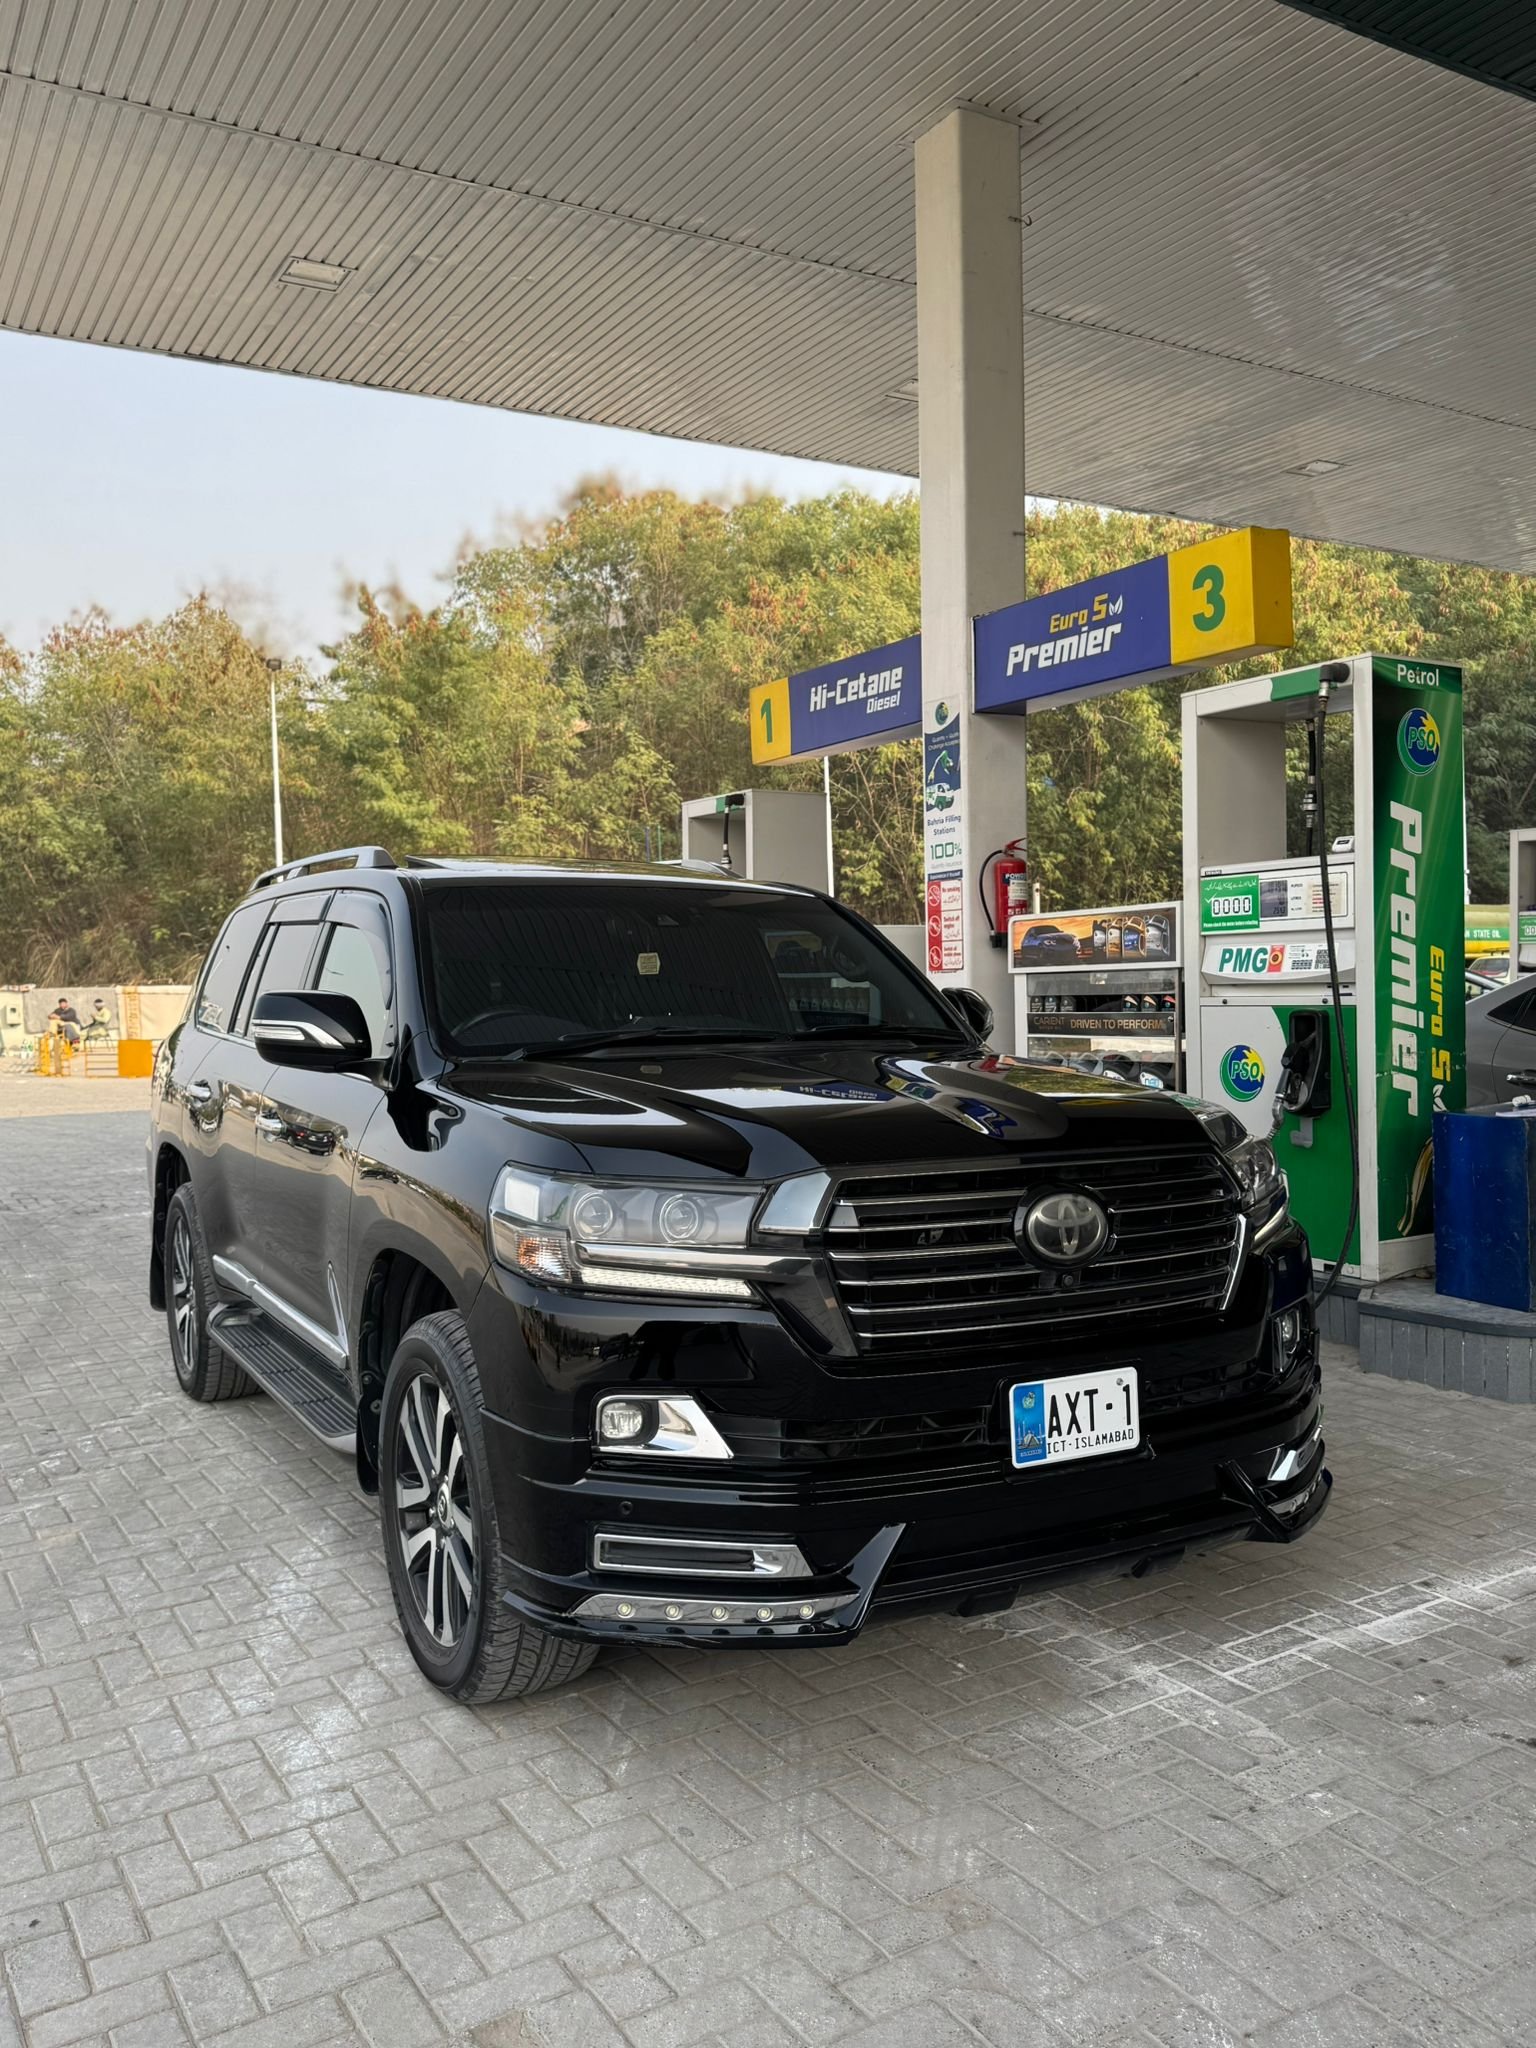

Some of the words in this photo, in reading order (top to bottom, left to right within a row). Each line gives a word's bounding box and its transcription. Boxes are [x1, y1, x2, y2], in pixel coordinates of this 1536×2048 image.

[1192, 564, 1226, 632] 3
[1049, 609, 1088, 634] Euro
[1092, 593, 1109, 621] 5
[1006, 623, 1122, 677] Premier
[1397, 663, 1439, 687] Petrol
[810, 667, 903, 712] Hi-Cetane
[866, 691, 901, 714] Diesel
[760, 698, 773, 744] 1
[1408, 727, 1436, 751] PSO
[933, 826, 955, 836] Stations
[930, 842, 962, 860] 100%
[1212, 897, 1251, 915] 0000
[1473, 929, 1491, 939] STATE
[1219, 947, 1269, 973] PMG
[1390, 801, 1424, 1117] Premier
[1430, 945, 1444, 1036] Euro
[1071, 1019, 1102, 1030] DRIVEN
[1102, 1019, 1115, 1029] TO
[1231, 1060, 1260, 1081] PSO
[1432, 1047, 1451, 1082] 5
[1048, 1384, 1131, 1438] AXT-1
